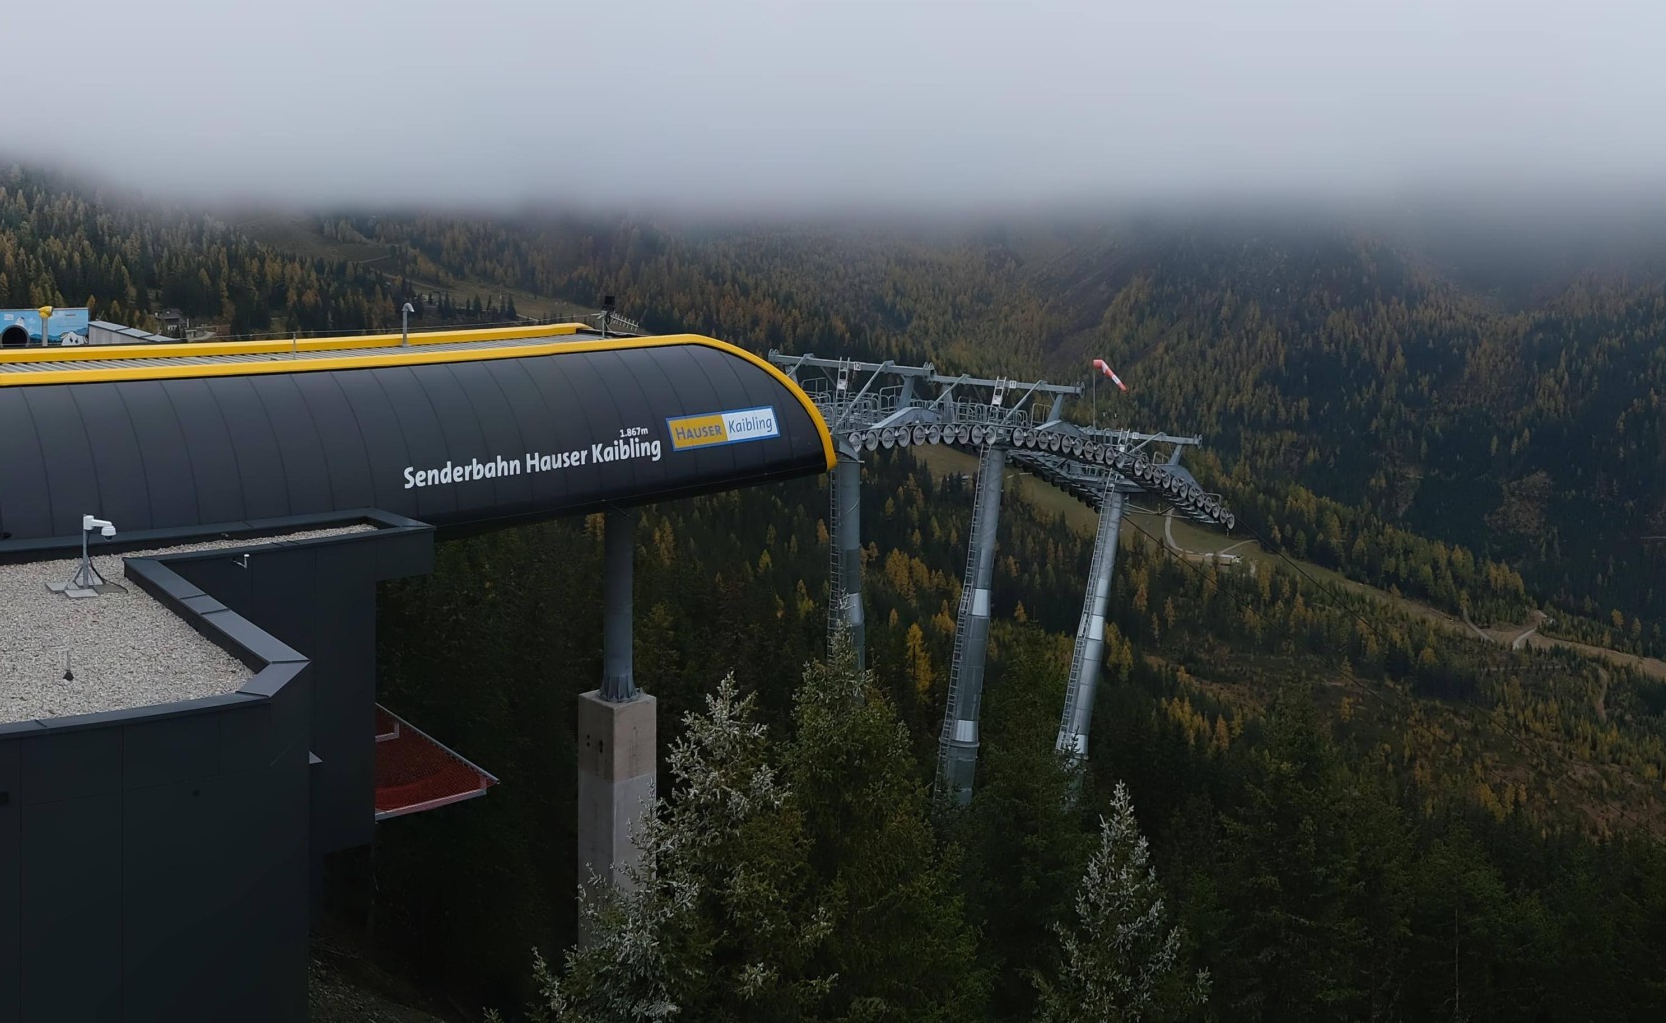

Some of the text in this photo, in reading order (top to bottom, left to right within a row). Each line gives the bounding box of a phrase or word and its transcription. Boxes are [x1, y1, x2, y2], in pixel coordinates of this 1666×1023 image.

[619, 427, 649, 438] 1.867m
[675, 418, 773, 440] HAUSER Kaibling
[403, 438, 662, 489] Senderbahn Hauser Kaibling
